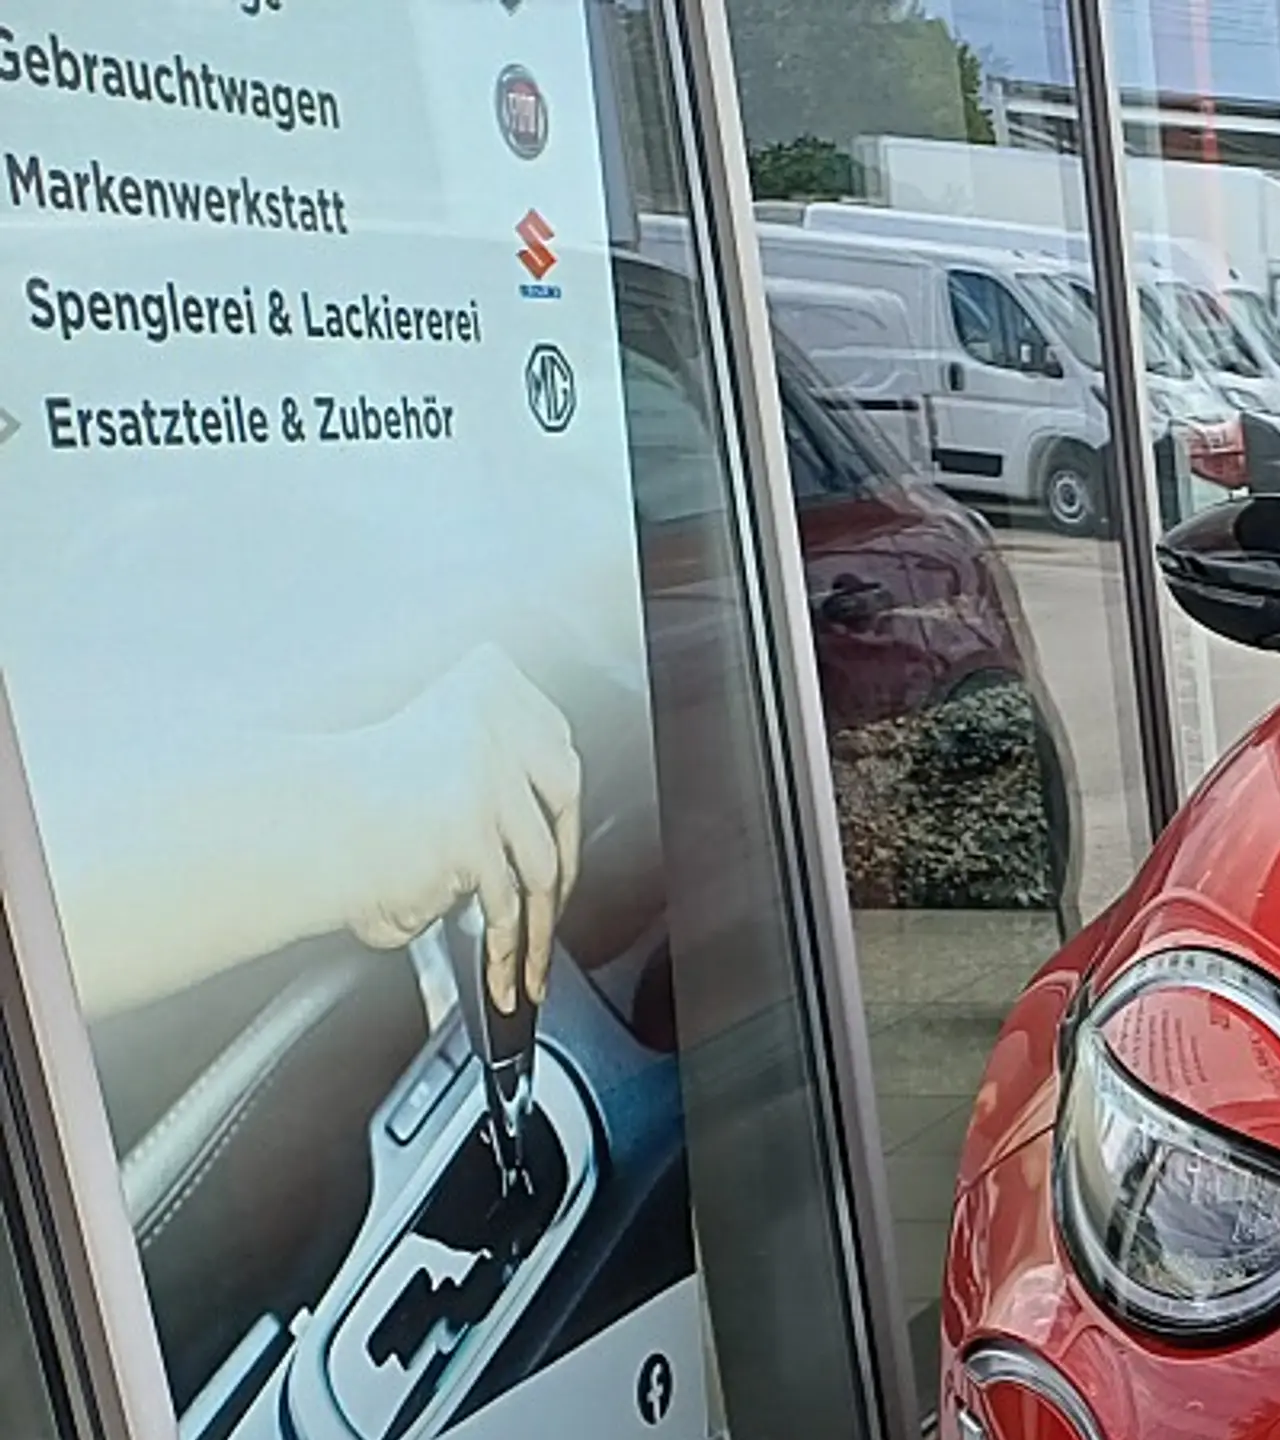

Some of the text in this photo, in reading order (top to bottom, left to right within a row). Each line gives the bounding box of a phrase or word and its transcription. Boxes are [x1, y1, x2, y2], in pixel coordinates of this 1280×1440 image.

[0, 26, 341, 131] Gebrauchtwagen
[4, 153, 349, 236] Markenwerkstatt
[25, 277, 481, 343] Spenglerei & Lackiererei
[45, 397, 454, 448] Ersatzteile & Zubehör
